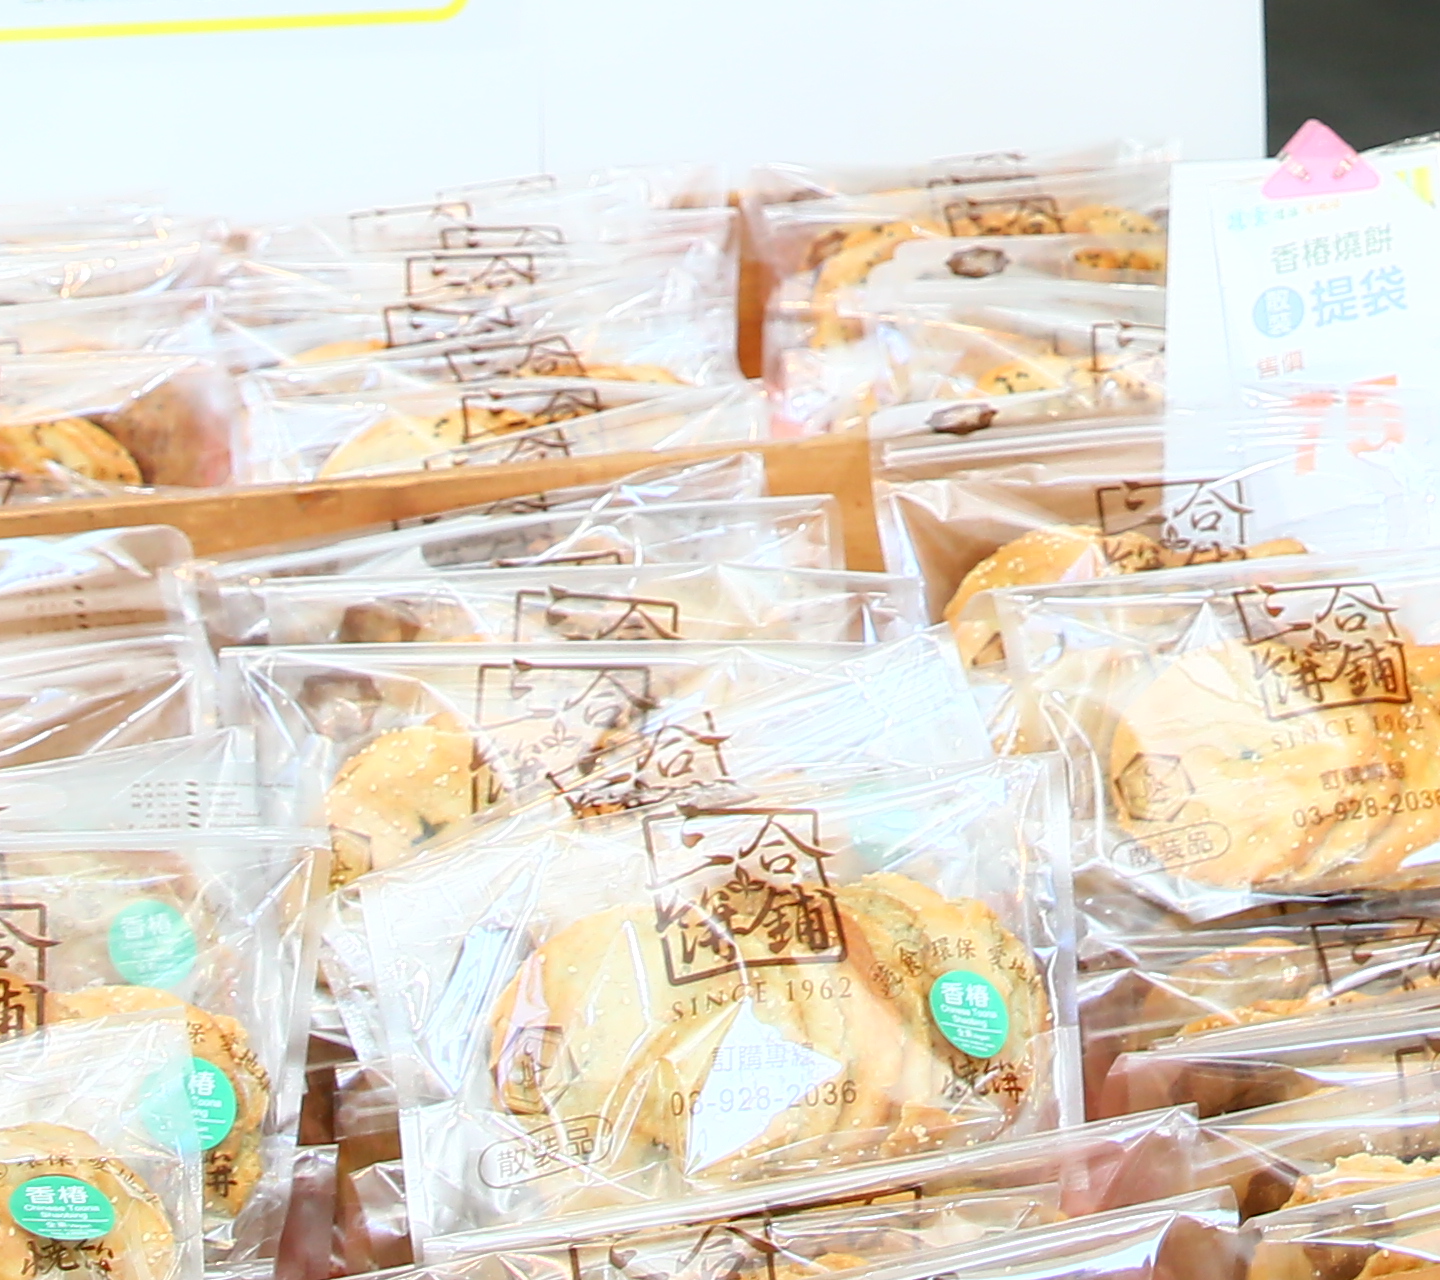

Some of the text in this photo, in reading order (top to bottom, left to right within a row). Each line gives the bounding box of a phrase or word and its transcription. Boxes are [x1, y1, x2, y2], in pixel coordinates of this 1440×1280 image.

[1271, 223, 1394, 275] 香椿燒餅
[1311, 265, 1408, 329] 提袋
[1256, 349, 1305, 380] 售價
[1291, 373, 1407, 475] 75
[1272, 713, 1426, 752] SINCE 1962
[1128, 830, 1216, 868] 散裝品
[672, 976, 853, 1023] SINCE 1962
[941, 981, 991, 1008] 香椿
[712, 1042, 815, 1074] 訂購專線
[669, 1079, 858, 1117] 03-928-2036
[496, 1126, 597, 1179] 散裝品
[25, 1184, 90, 1205] 香椿
